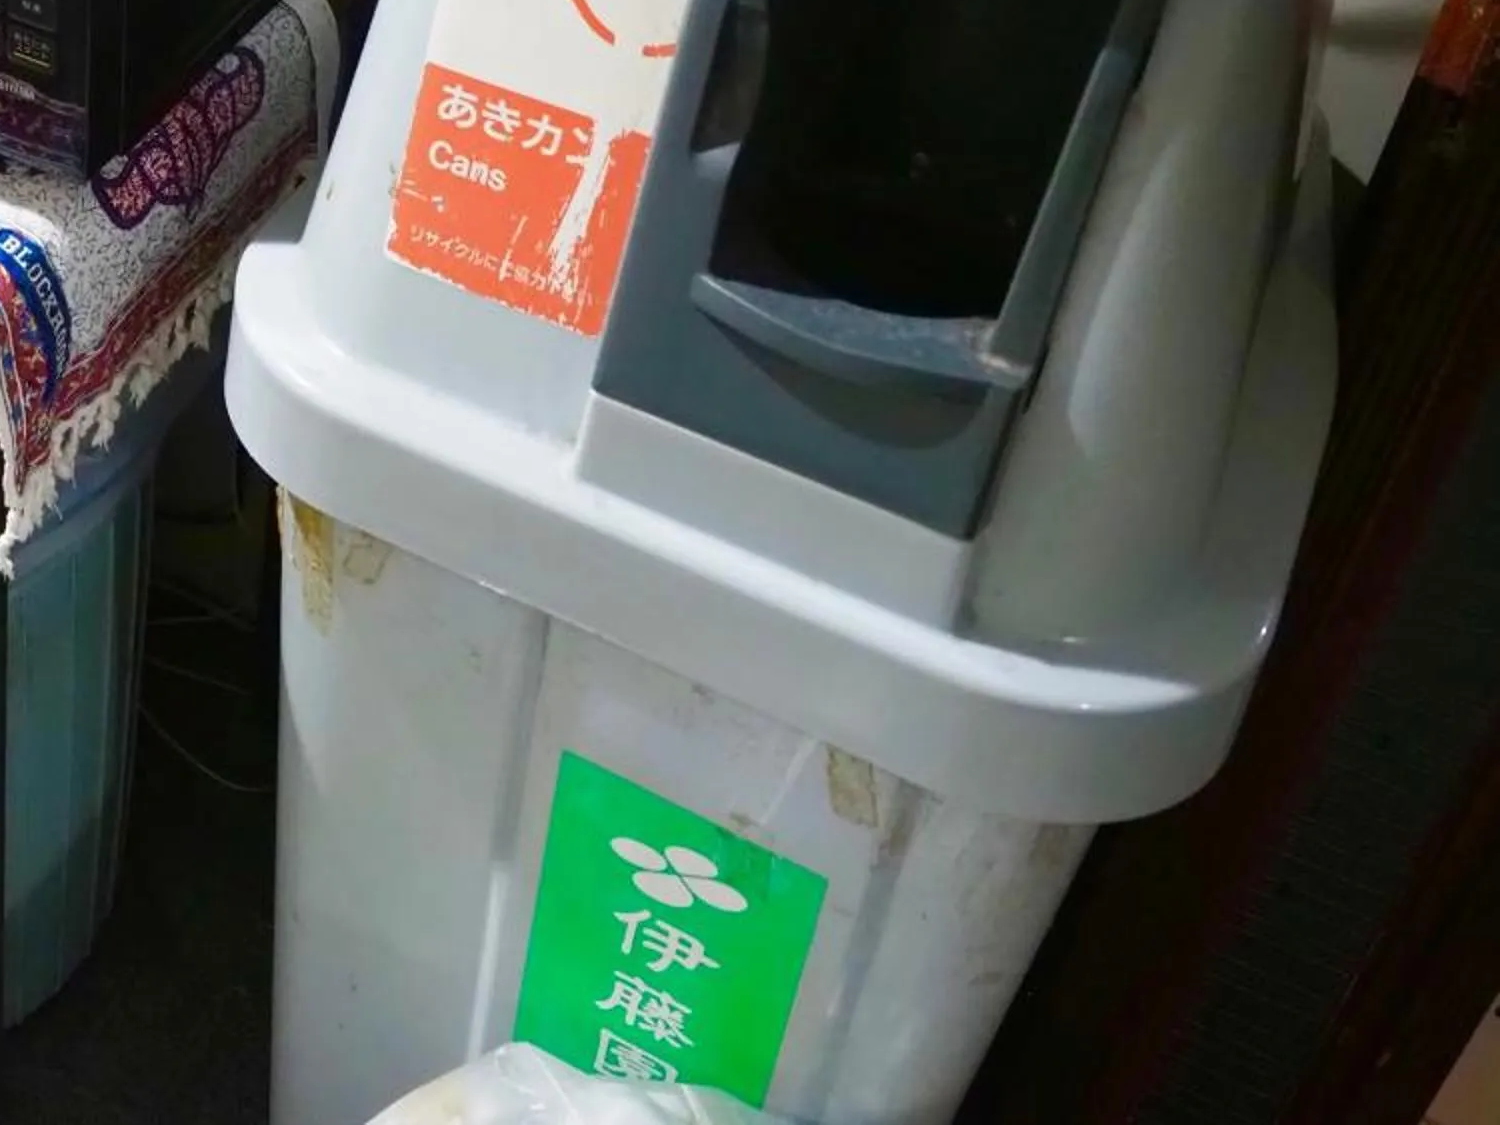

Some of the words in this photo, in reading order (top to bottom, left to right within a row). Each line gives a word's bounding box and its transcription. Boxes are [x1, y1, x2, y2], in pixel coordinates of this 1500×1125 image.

[428, 140, 509, 192] Cans
[593, 909, 721, 1084] 伊藤園
